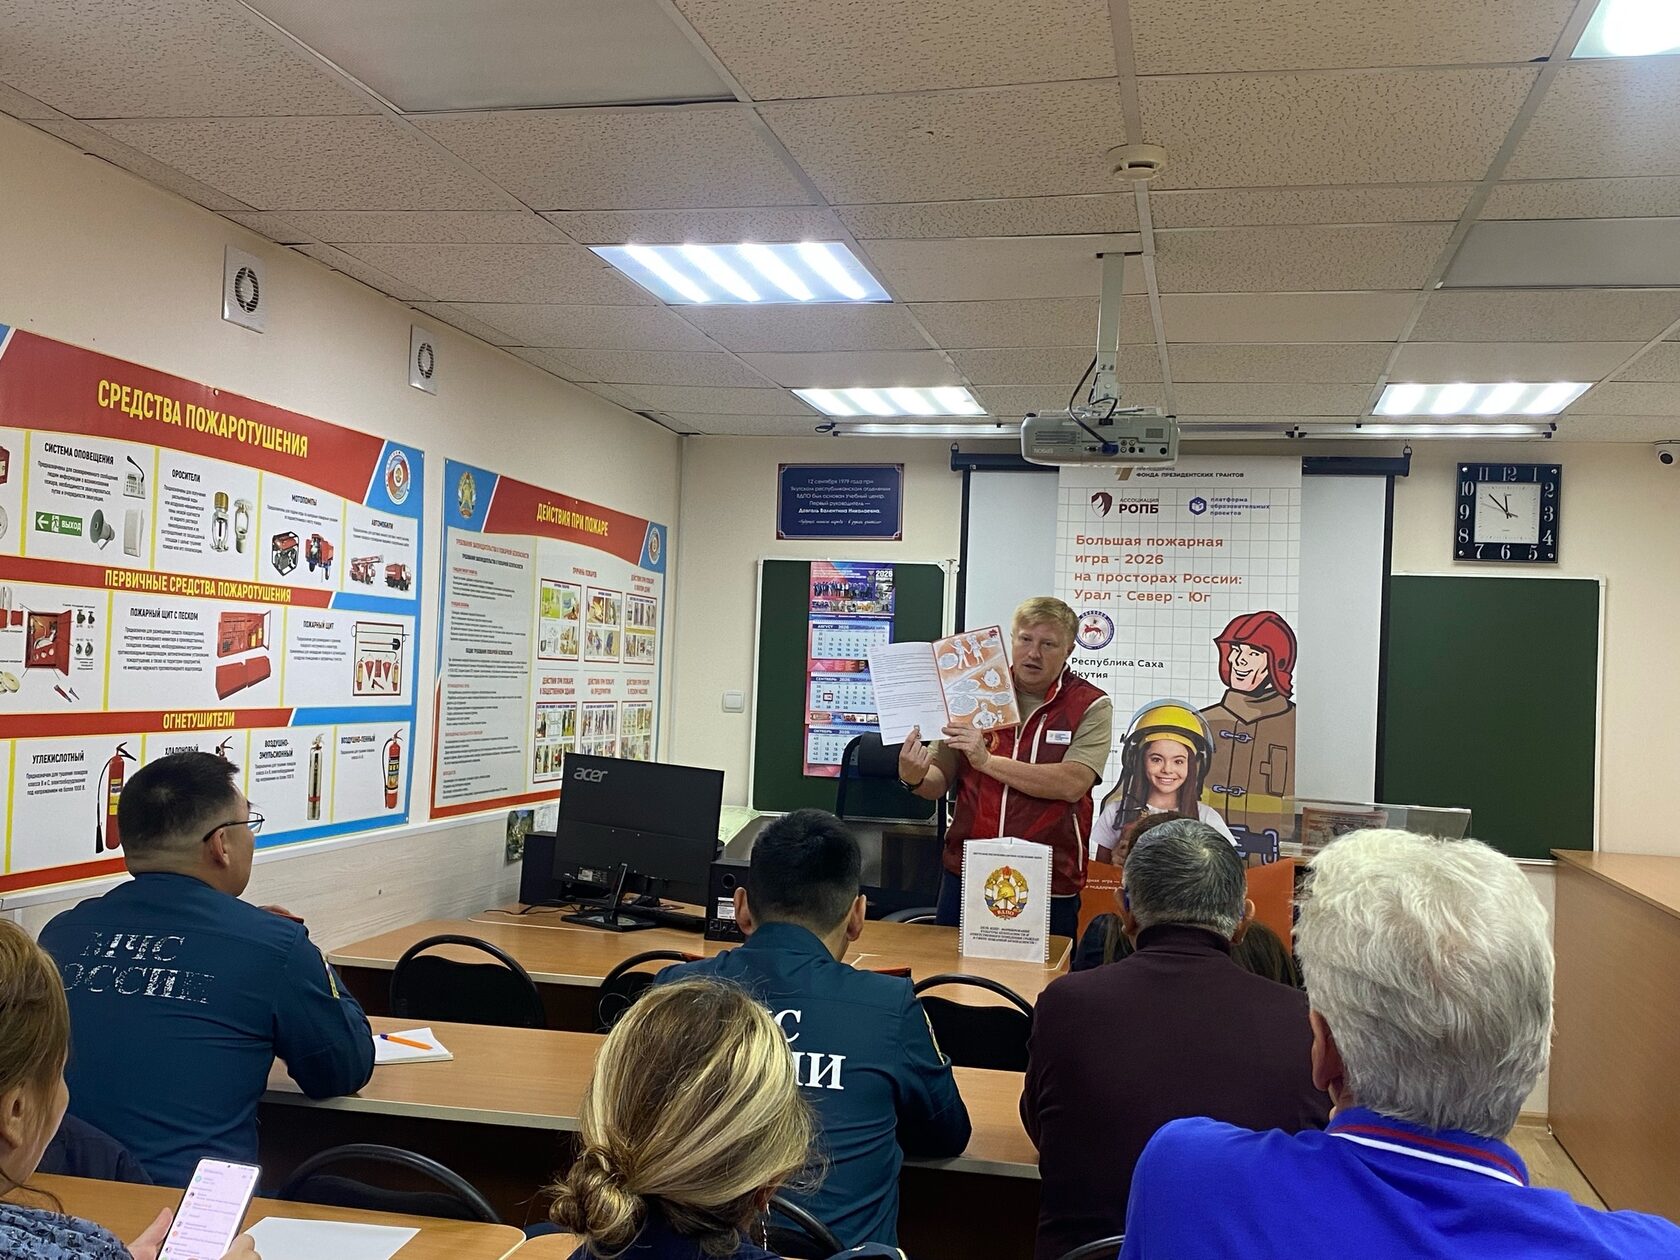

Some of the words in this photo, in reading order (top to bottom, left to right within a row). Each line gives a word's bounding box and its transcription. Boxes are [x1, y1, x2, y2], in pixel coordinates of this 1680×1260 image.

[98, 380, 182, 426] СРЕДСТВА
[186, 404, 308, 458] ПОЖАРОТУШЕНИЯ
[44, 443, 73, 457] СИСТЕМА
[74, 449, 114, 465] ОПОВЕЩЕНИЯ
[172, 469, 200, 482] ОРОСИТЕЛИ
[1479, 467, 1489, 481] 11
[1503, 466, 1517, 481] 12
[1533, 467, 1537, 482] 1
[1461, 481, 1474, 496] 10
[1544, 482, 1554, 498] 2
[1119, 504, 1159, 513] РОПБ
[1460, 504, 1470, 520] 9
[1544, 506, 1554, 522] 3
[61, 520, 81, 531] ВЫХОД
[537, 502, 570, 527] ДЕЙСТВИЯ
[572, 512, 584, 530] ПРИ
[585, 515, 608, 536] ПОЖАРЕ
[1076, 535, 1142, 546] Большая
[1147, 537, 1223, 549] пожарная
[1458, 528, 1469, 543] 8
[1542, 530, 1553, 546] 4
[1075, 555, 1109, 565] игра
[1125, 554, 1164, 565] 2026
[1474, 544, 1484, 559] 7
[1501, 544, 1510, 559] 6
[1528, 545, 1538, 560] 5
[105, 569, 167, 591] ПЕРВИЧНЫЕ
[170, 577, 216, 596] СРЕДСТВА
[218, 582, 291, 602] ПОЖАРОТУШЕНИЯ
[1074, 573, 1091, 581] на
[1096, 574, 1177, 585] просторах
[1183, 574, 1242, 584] России:
[1074, 589, 1111, 601] Урал
[1127, 591, 1172, 604] Север
[1188, 592, 1211, 603] Юг
[130, 608, 160, 618] ПОЖАРНЫЙ
[161, 610, 172, 620] ЩИТ
[179, 612, 198, 621] ПЕСКОМ
[1071, 657, 1134, 667] Республика
[1138, 660, 1164, 668] Саха
[163, 712, 235, 729] ОГНЕТУШИТЕЛИ
[32, 750, 84, 764] УГЛЕКИСЛОТНЫЙ
[574, 767, 608, 782] acer
